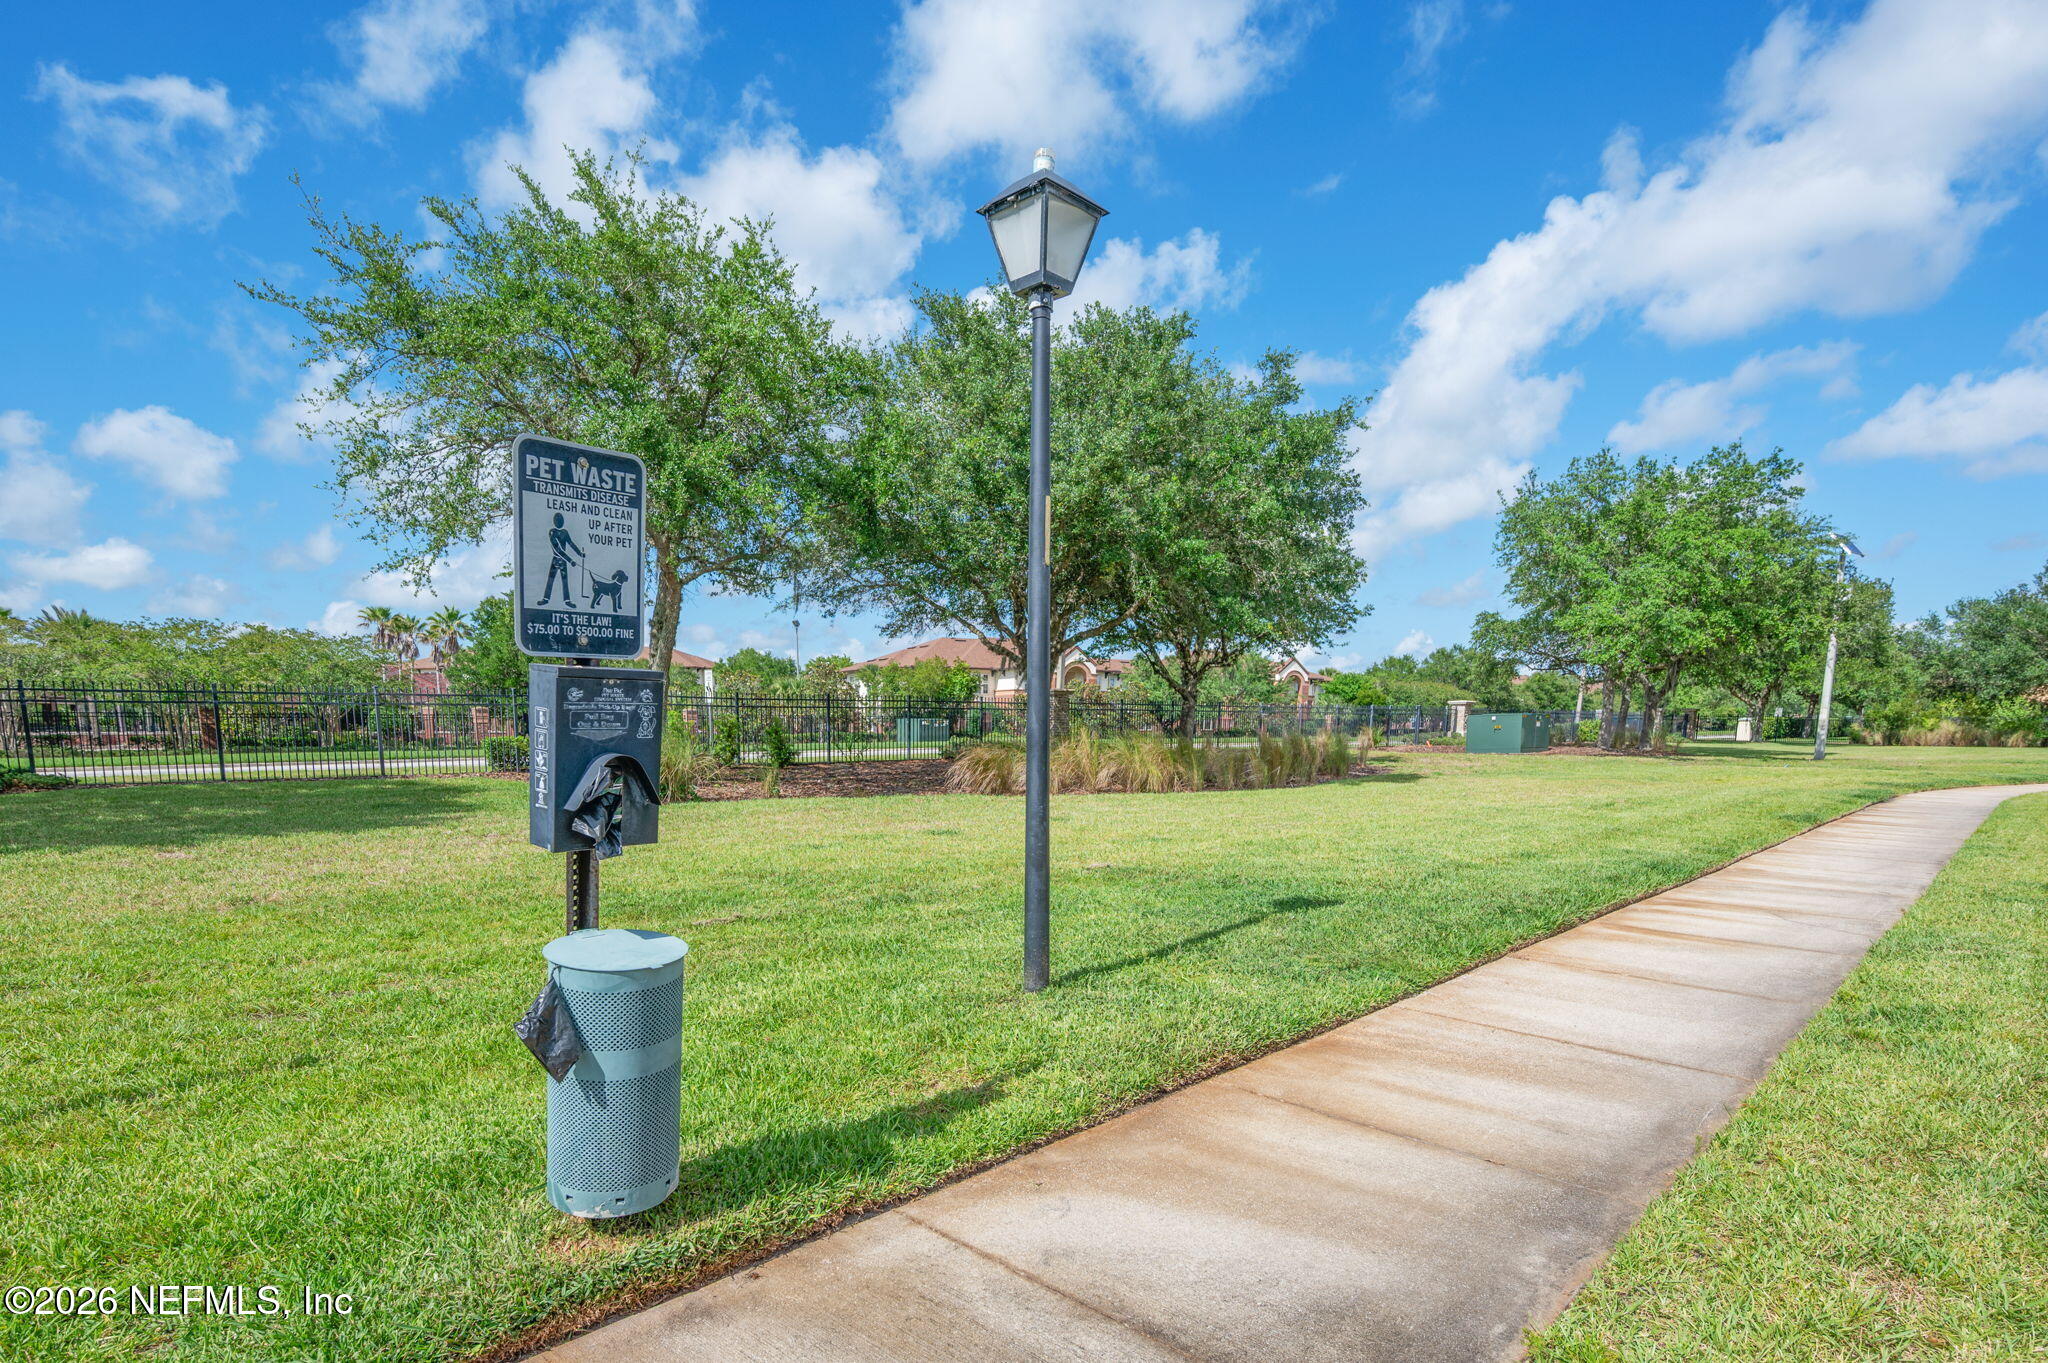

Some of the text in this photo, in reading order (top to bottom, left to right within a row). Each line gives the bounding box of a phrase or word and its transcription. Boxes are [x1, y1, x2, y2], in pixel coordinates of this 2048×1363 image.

[526, 454, 636, 494] PET WASTE
[533, 480, 630, 507] TRANSMITS DISEASE
[546, 498, 633, 521] LEASH AND CLEAN
[588, 519, 633, 535] UP AFTER
[588, 533, 633, 549] YOUR PET
[552, 613, 612, 627] IT'S THE LAW!
[527, 622, 635, 639] $75.00 TO $500.00 FINE
[592, 720, 600, 728] &
[601, 720, 621, 728] Down
[600, 713, 614, 721] Bag
